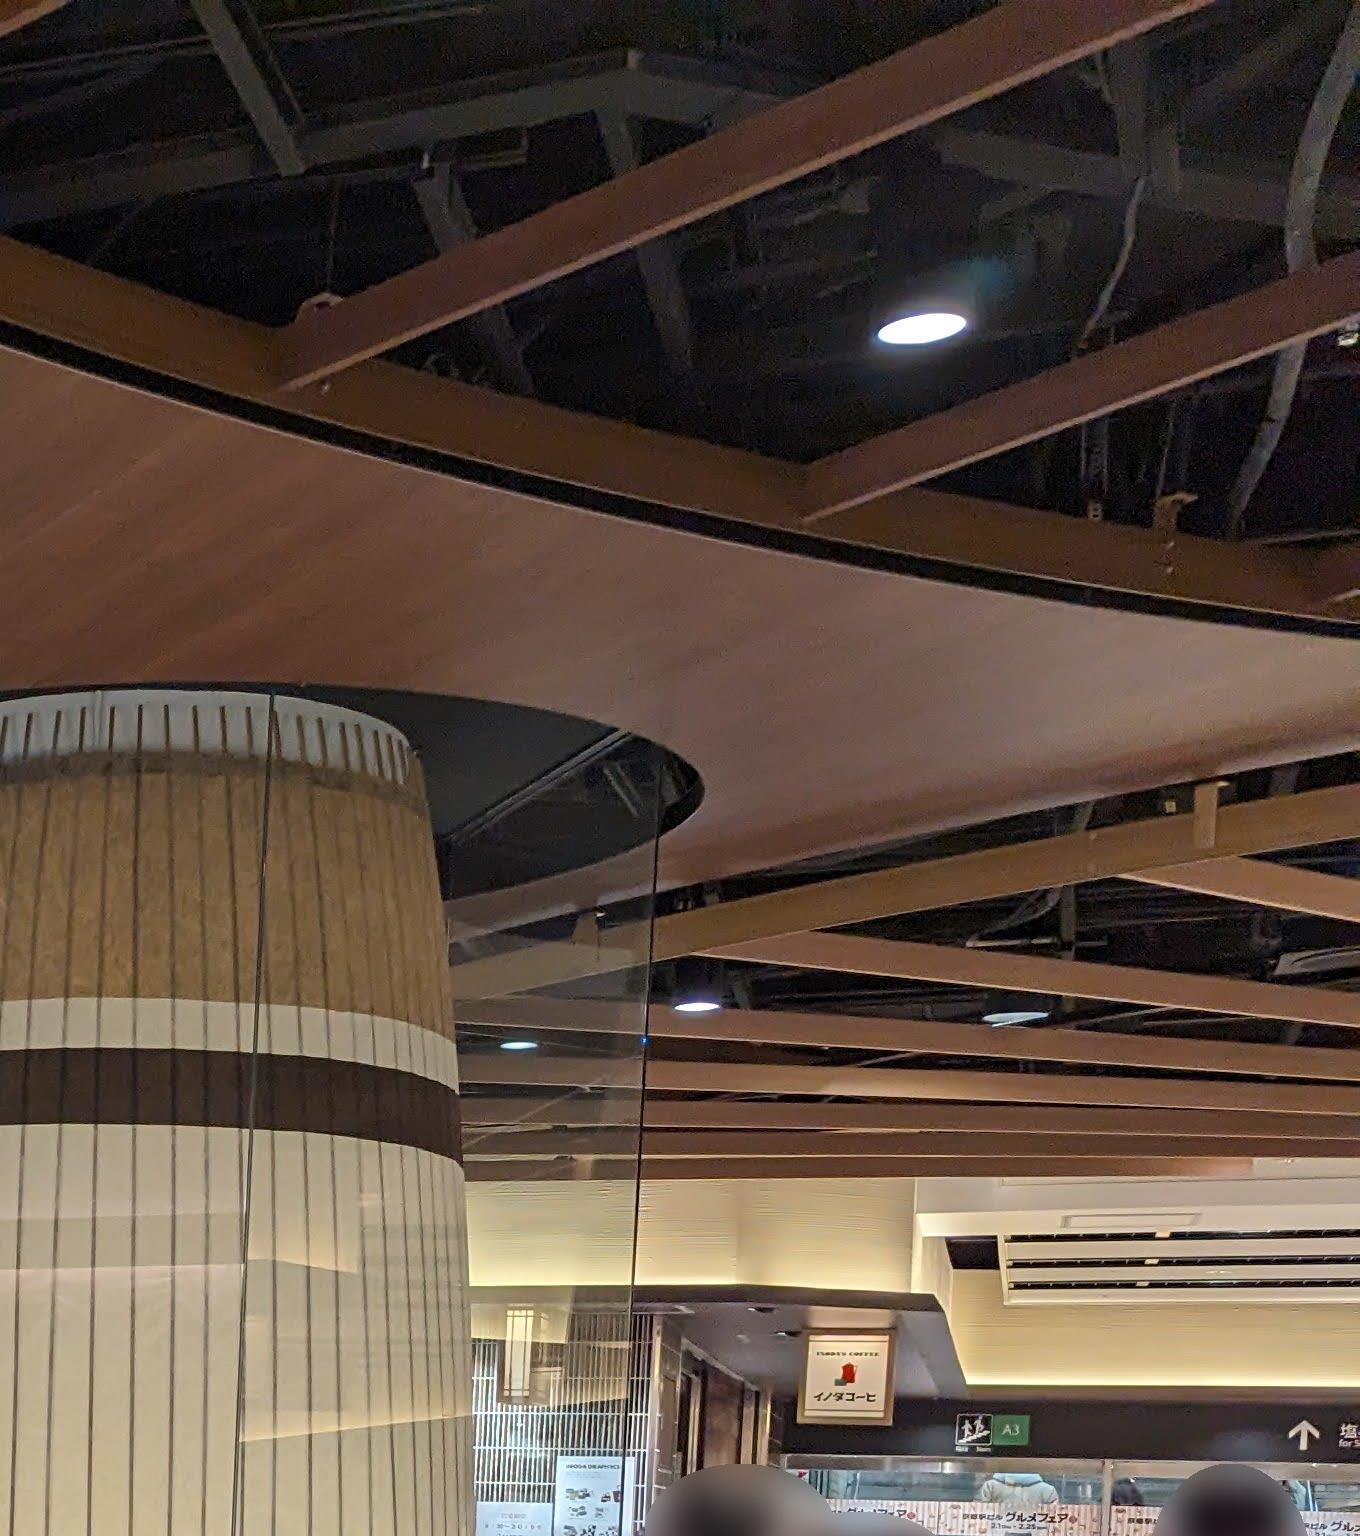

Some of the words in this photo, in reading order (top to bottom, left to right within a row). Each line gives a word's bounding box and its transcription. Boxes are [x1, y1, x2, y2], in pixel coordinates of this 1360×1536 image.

[813, 1391, 877, 1403] イノダコーヒ
[1001, 1423, 1020, 1436] A3
[1339, 1439, 1352, 1448] for
[1005, 1512, 1069, 1524] グルメフェア
